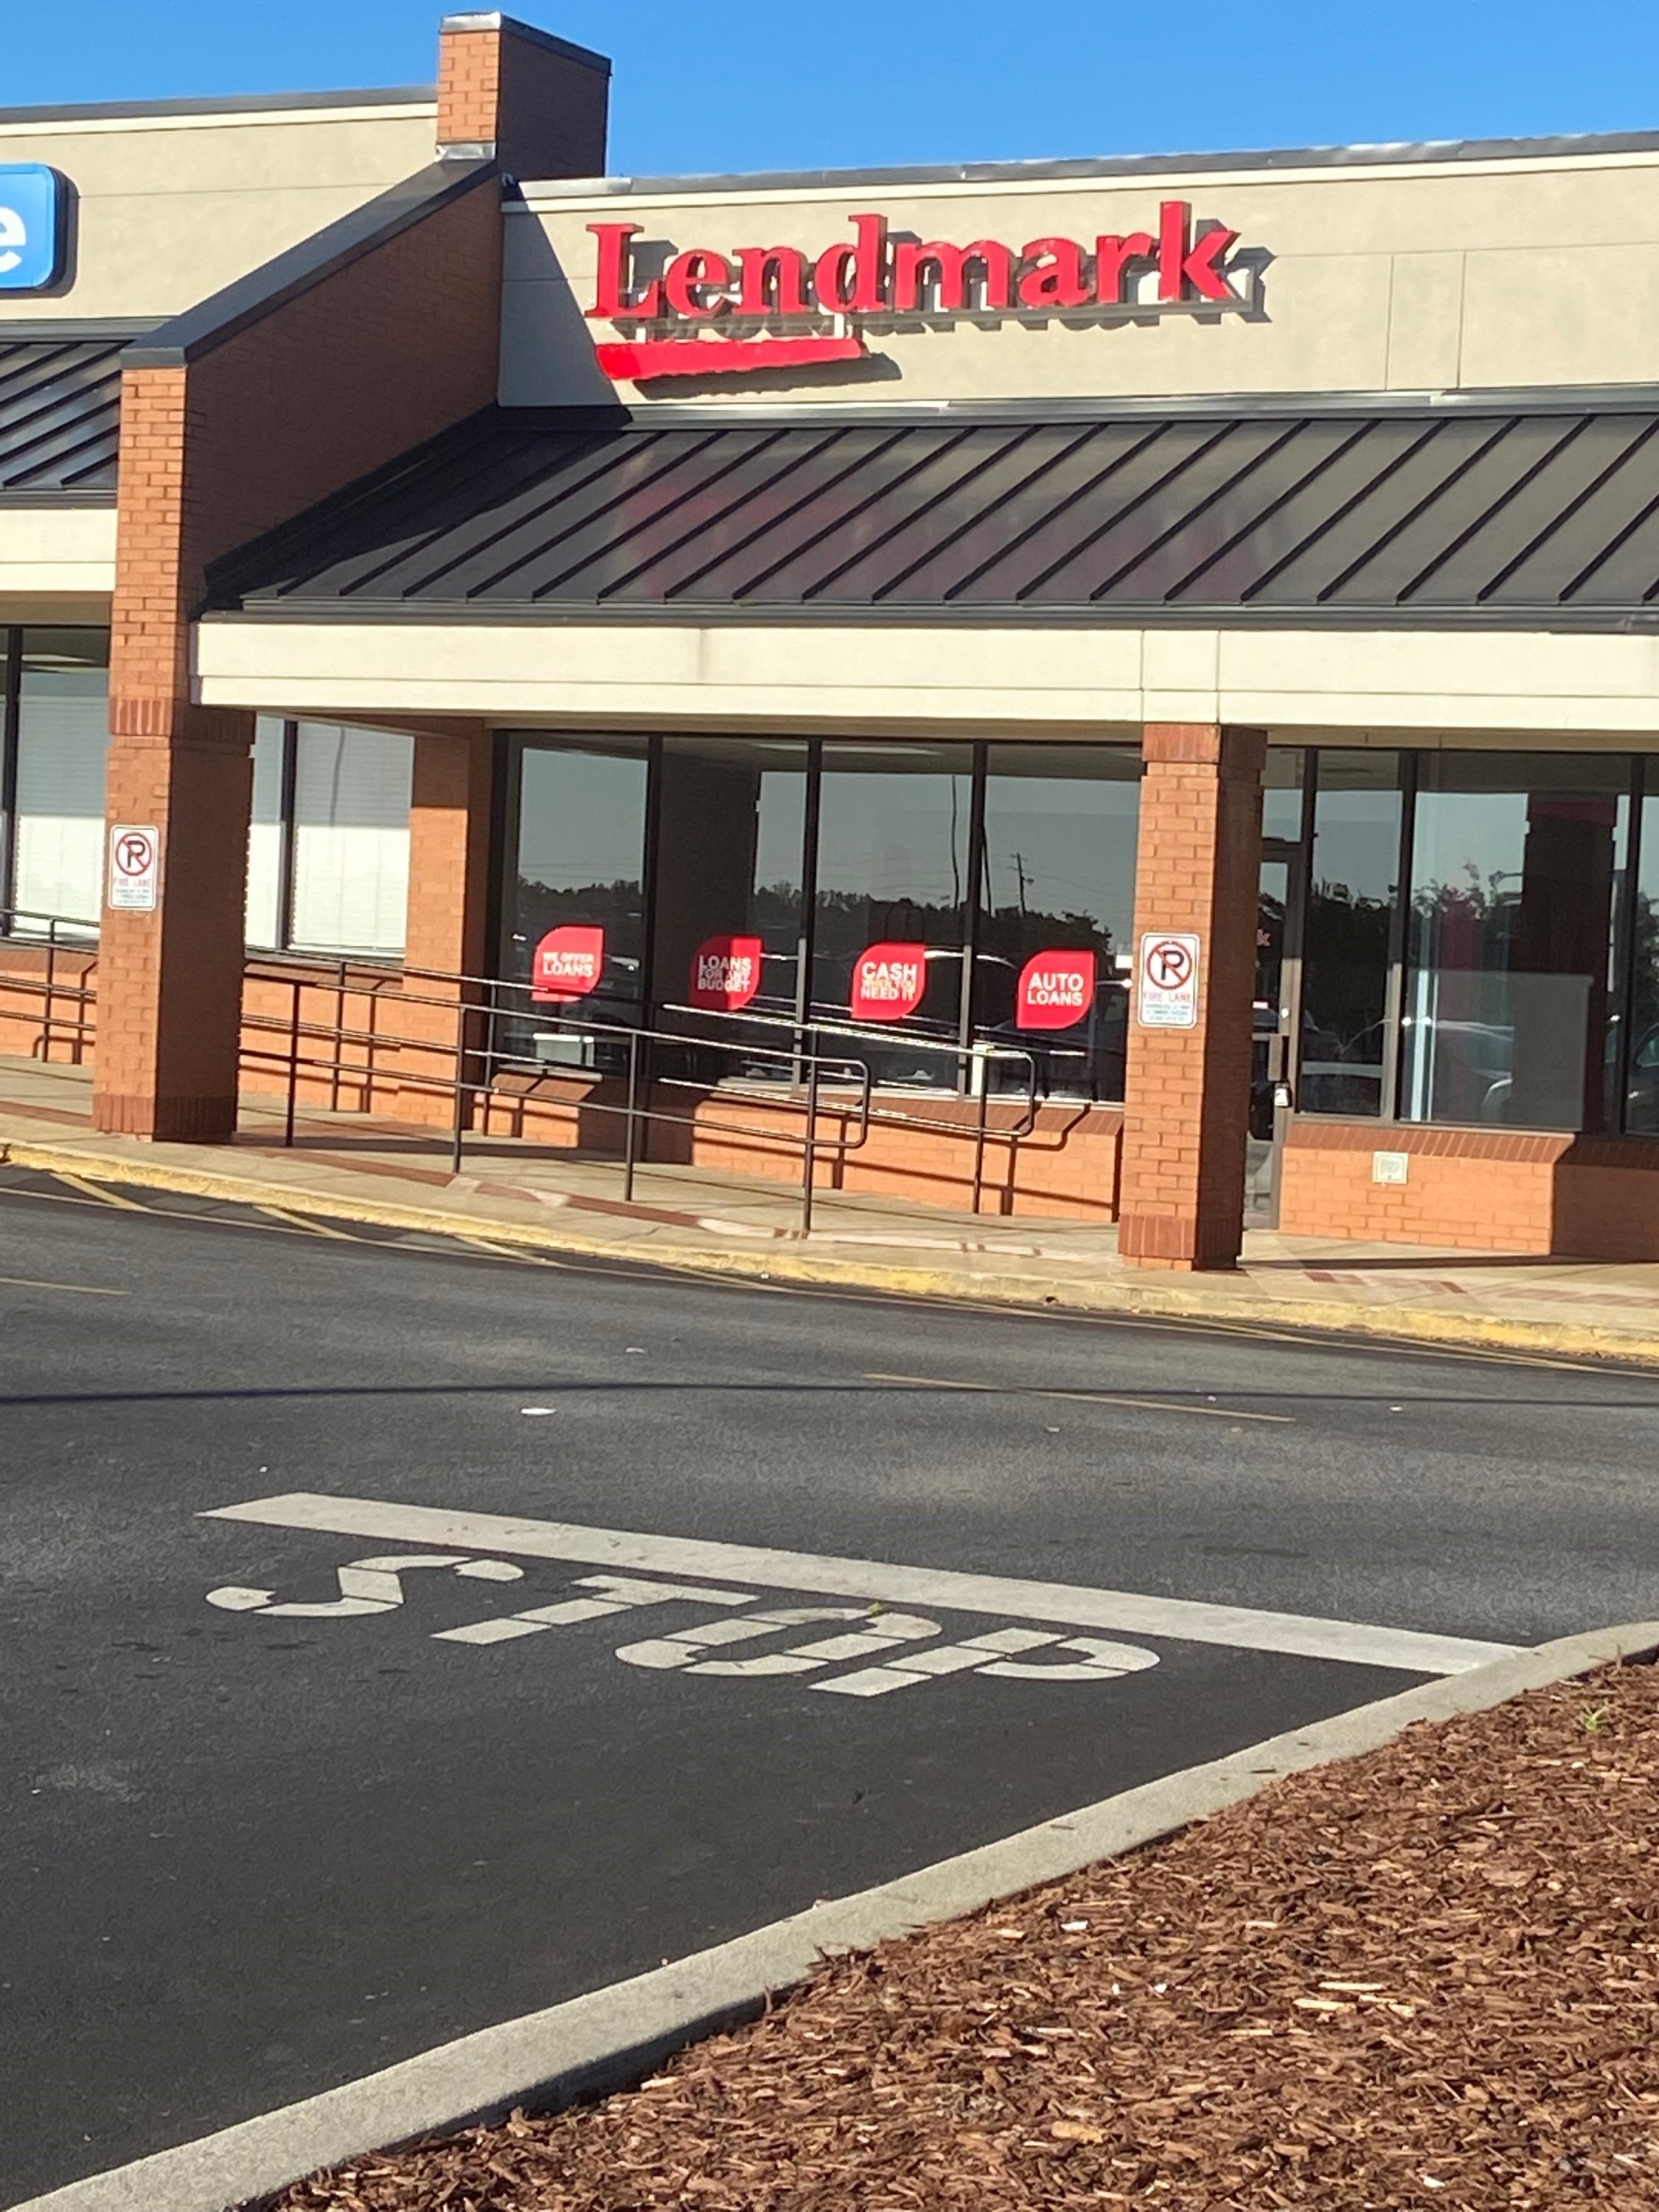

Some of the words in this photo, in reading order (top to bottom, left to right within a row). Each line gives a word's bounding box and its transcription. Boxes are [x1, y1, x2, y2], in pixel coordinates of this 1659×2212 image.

[585, 201, 1240, 319] Lendmark
[543, 961, 594, 978] LOANS
[698, 955, 751, 972] LOANS
[862, 961, 918, 981] CASH
[698, 978, 751, 993] BUDGET
[1028, 972, 1084, 992] AUTO
[860, 987, 899, 1000] NEED
[1027, 990, 1083, 1007] LOANS
[205, 1554, 1161, 1697] STOP
